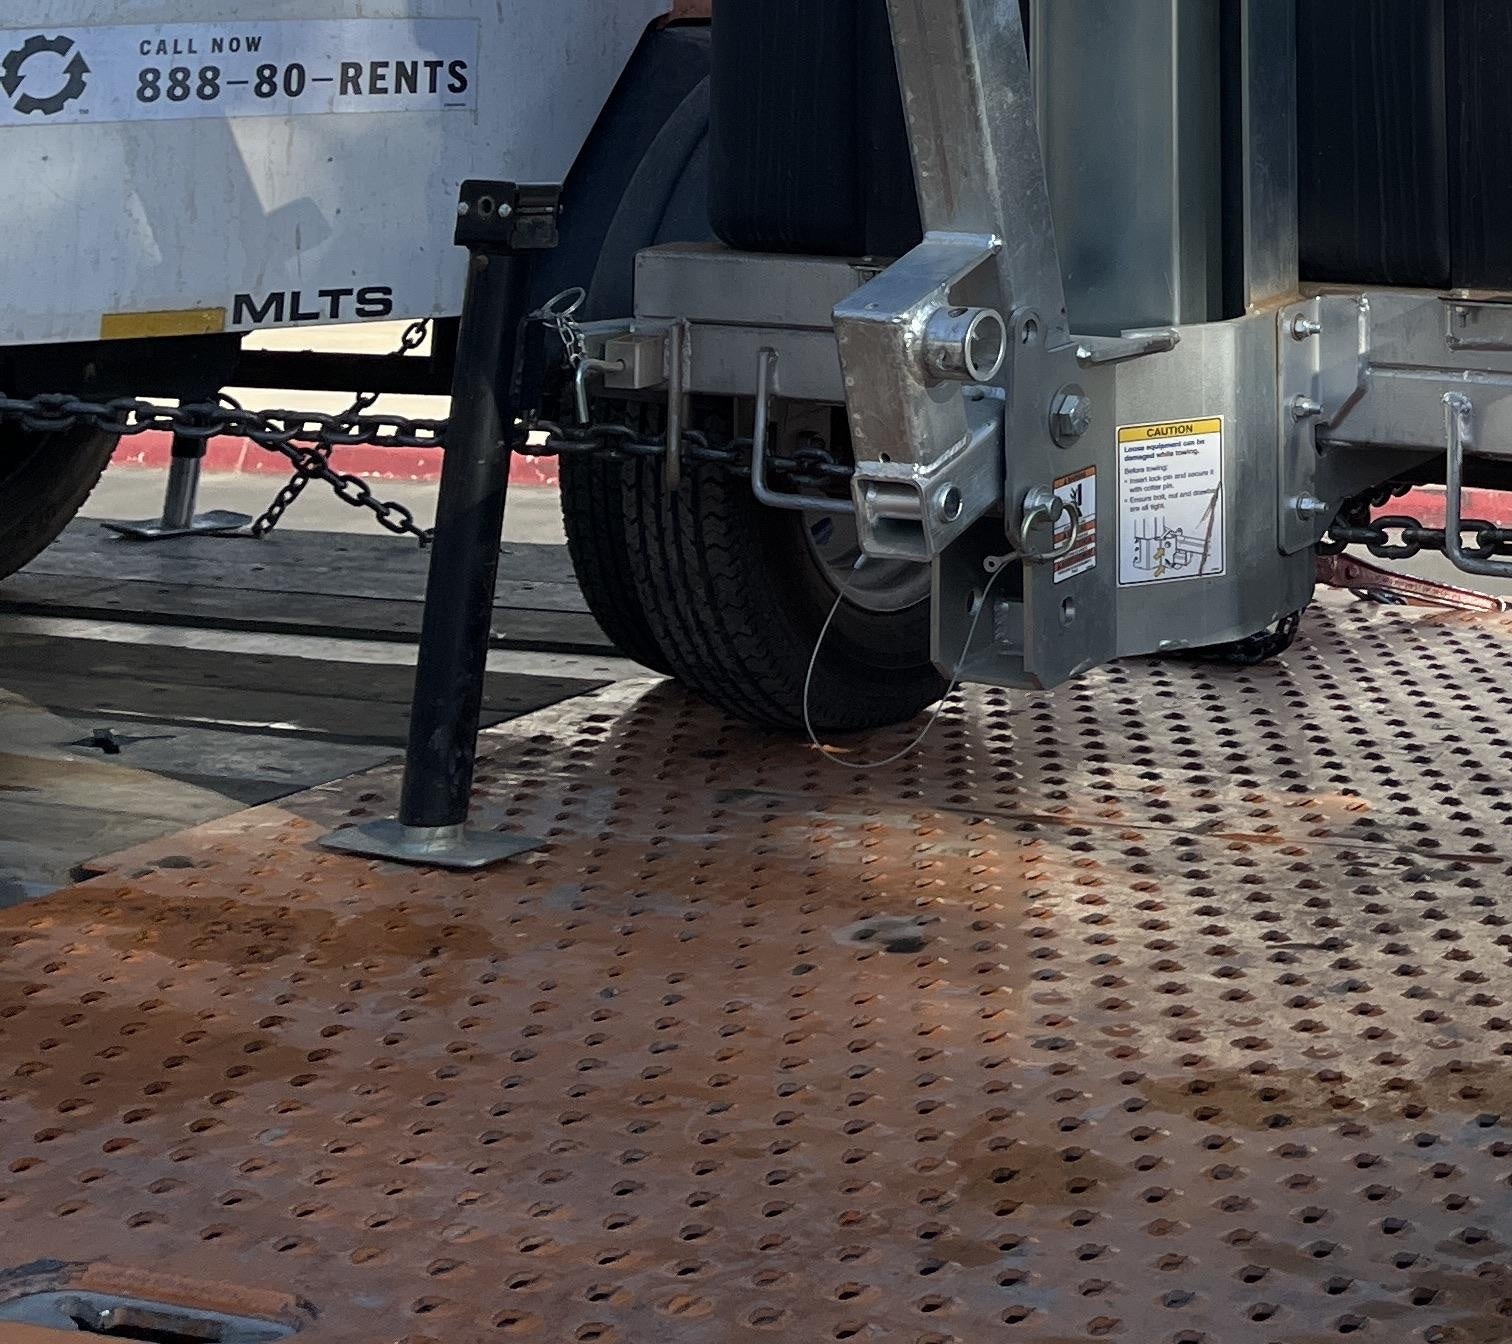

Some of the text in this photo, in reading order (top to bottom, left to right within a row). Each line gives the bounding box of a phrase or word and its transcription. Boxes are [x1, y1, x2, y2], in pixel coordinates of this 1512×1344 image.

[139, 36, 262, 55] CALL NOW
[136, 60, 469, 103] 888-80-RENTS
[232, 286, 393, 324] MLTS
[1146, 424, 1194, 438] CAUTION
[1146, 441, 1181, 451] equipment
[1124, 453, 1155, 461] damaged
